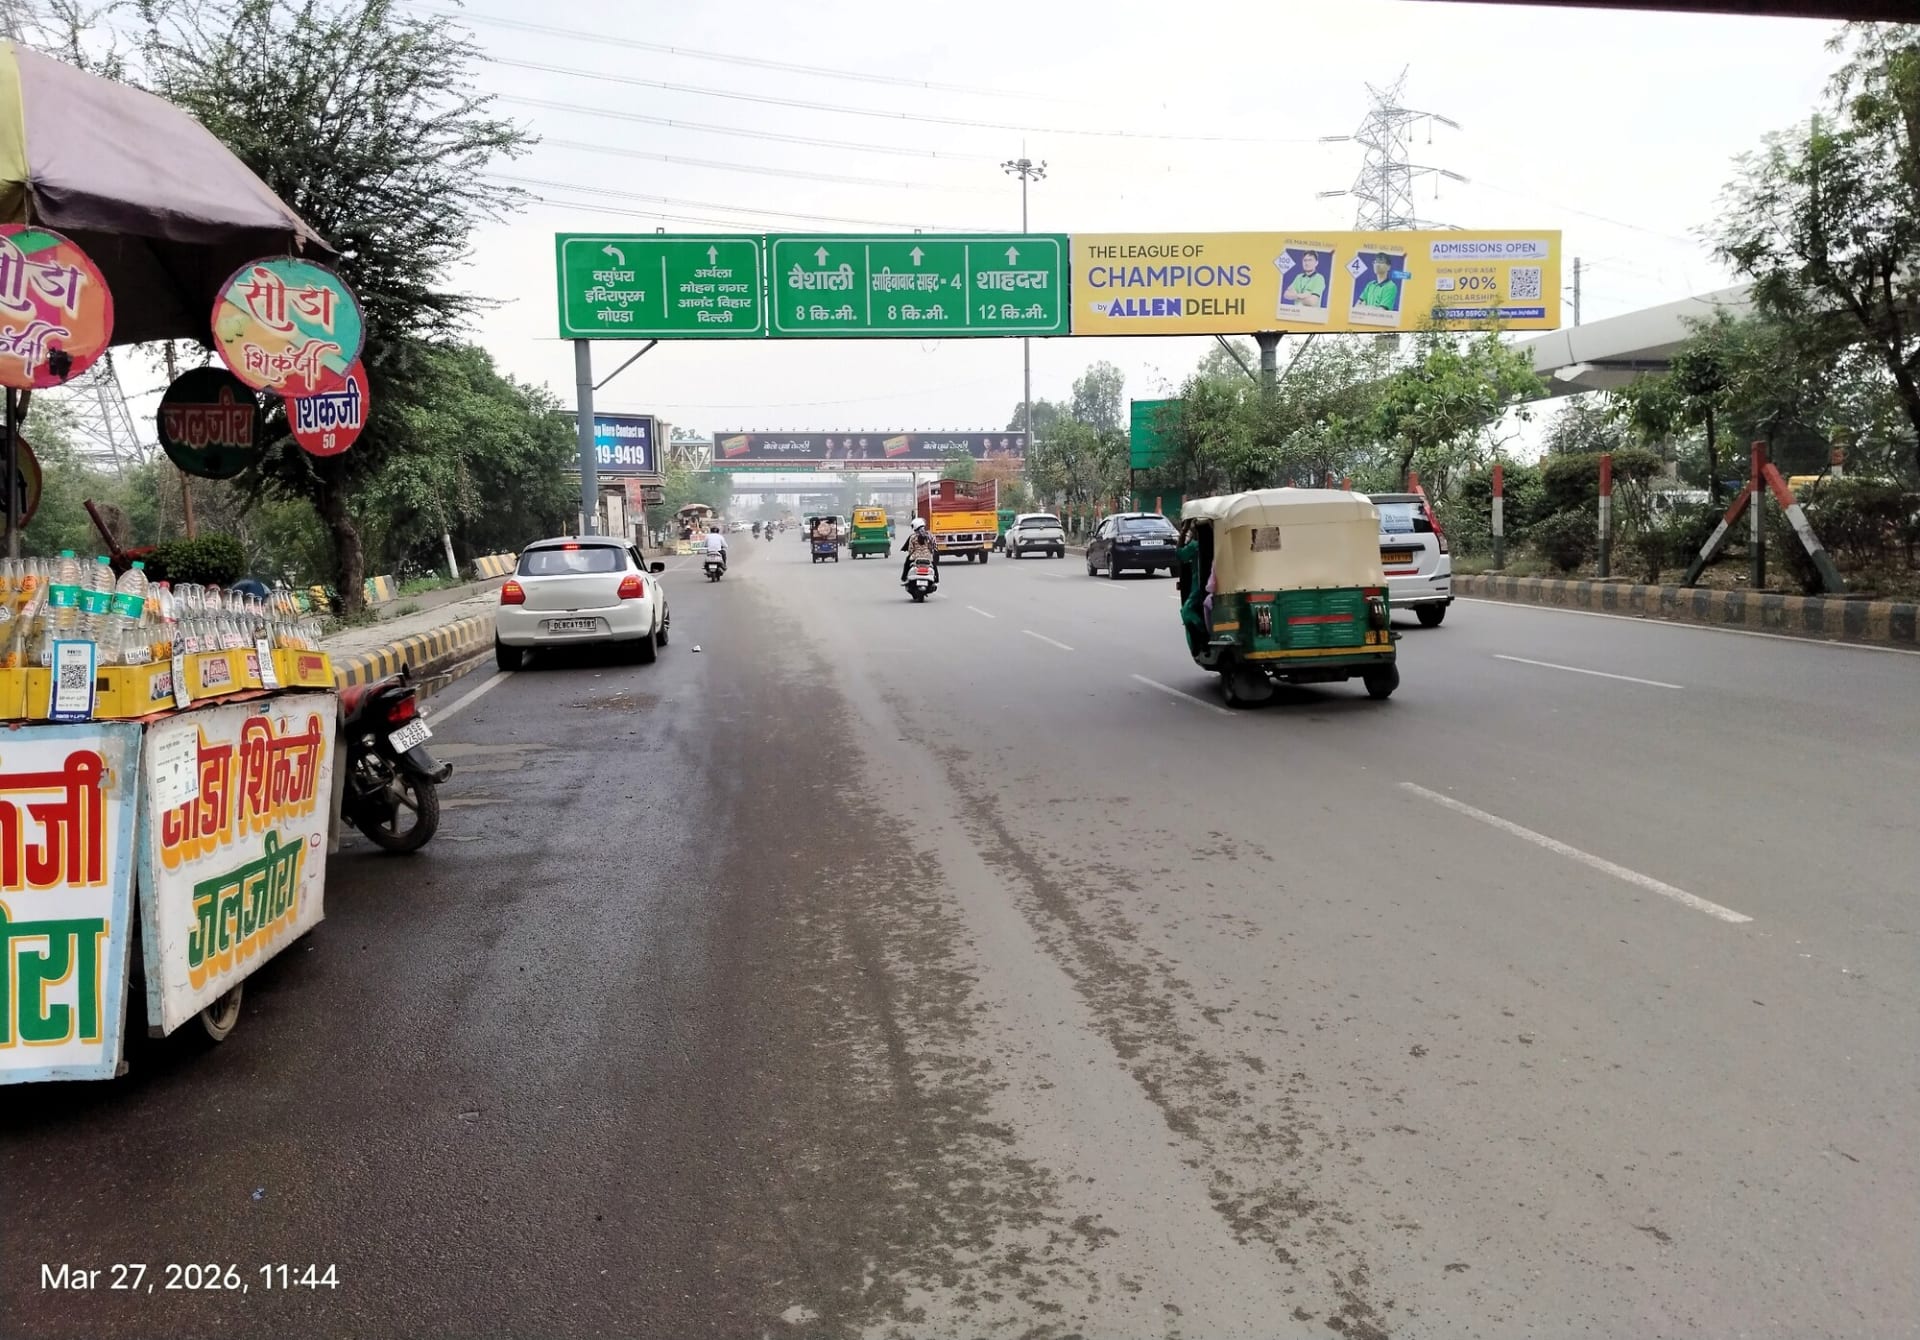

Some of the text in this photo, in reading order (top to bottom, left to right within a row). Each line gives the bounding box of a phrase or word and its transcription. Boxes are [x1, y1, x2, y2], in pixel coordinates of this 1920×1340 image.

[1089, 245, 1204, 258] THE LEAGUE OF
[1433, 243, 1536, 253] ADMISSIONS OPEN
[1351, 259, 1360, 271] 4
[593, 267, 635, 287] वसुंधरा
[788, 262, 855, 290] वैशाली
[872, 266, 915, 293] साहिबाबाद
[976, 270, 1049, 291] शाहदरा
[1088, 265, 1251, 288] CHAMPIONS
[1459, 276, 1496, 290] 90%
[680, 281, 748, 293] मोहन नगर
[584, 286, 645, 308] इंदिरापुरम
[678, 296, 751, 308] आनंद विहार
[597, 306, 634, 323] नोएडा
[796, 304, 857, 321] 8 कि.मी.
[888, 304, 948, 321] 8 कि.मी.
[979, 304, 1047, 320] 12 कि.मी.
[1097, 298, 1245, 317] by ALLEN DELHI
[697, 311, 733, 323] दिल्ली
[615, 424, 637, 438] Contact
[637, 427, 645, 438] us
[323, 435, 335, 448] 50
[188, 830, 303, 968] जलजीरा
